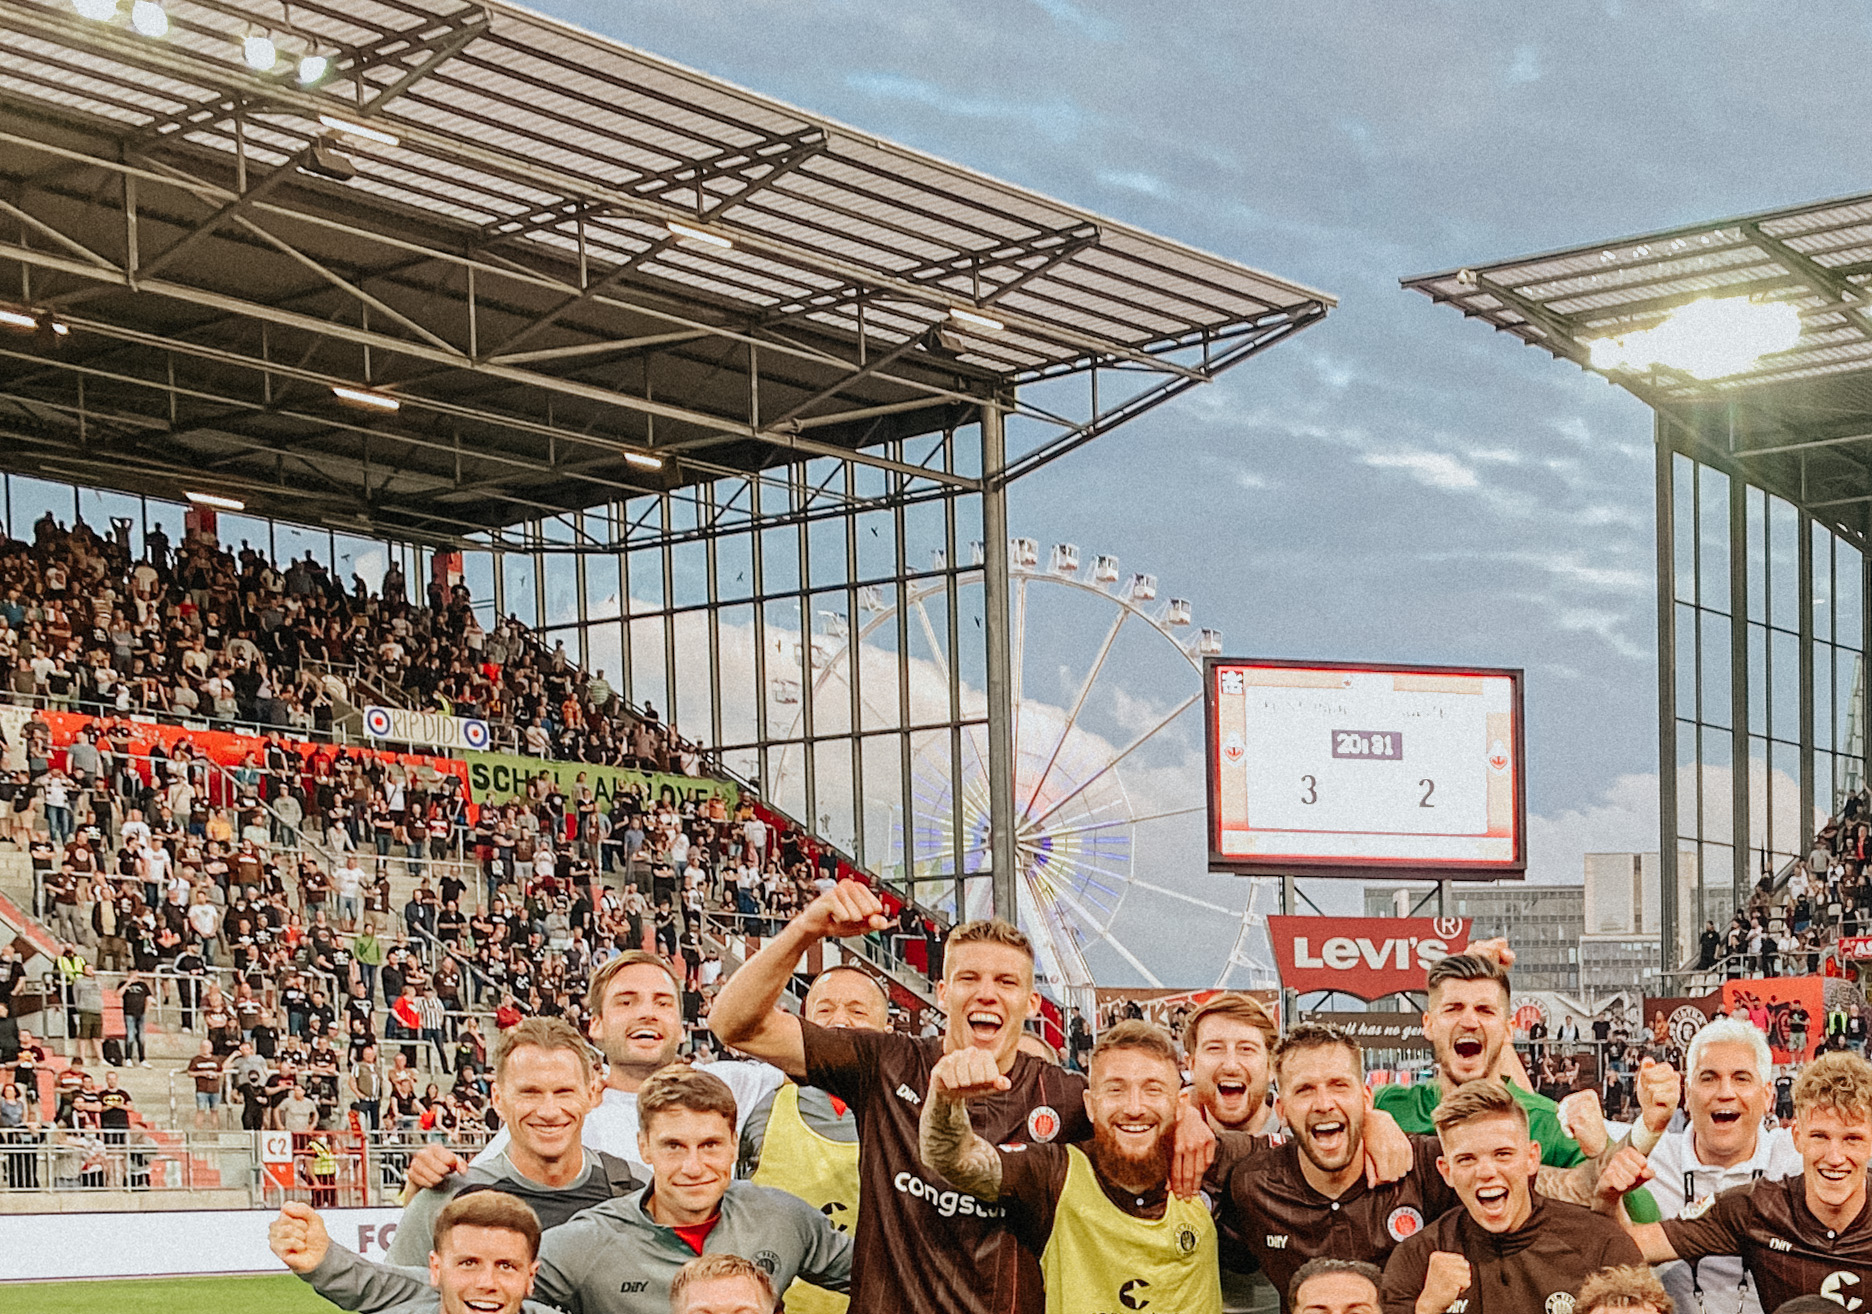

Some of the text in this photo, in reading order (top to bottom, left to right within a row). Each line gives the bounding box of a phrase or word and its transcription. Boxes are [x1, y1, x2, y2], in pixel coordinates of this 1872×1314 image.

[392, 709, 418, 739] RIP
[1301, 774, 1318, 805] 3
[1418, 778, 1435, 808] 2
[266, 1138, 288, 1156] C2
